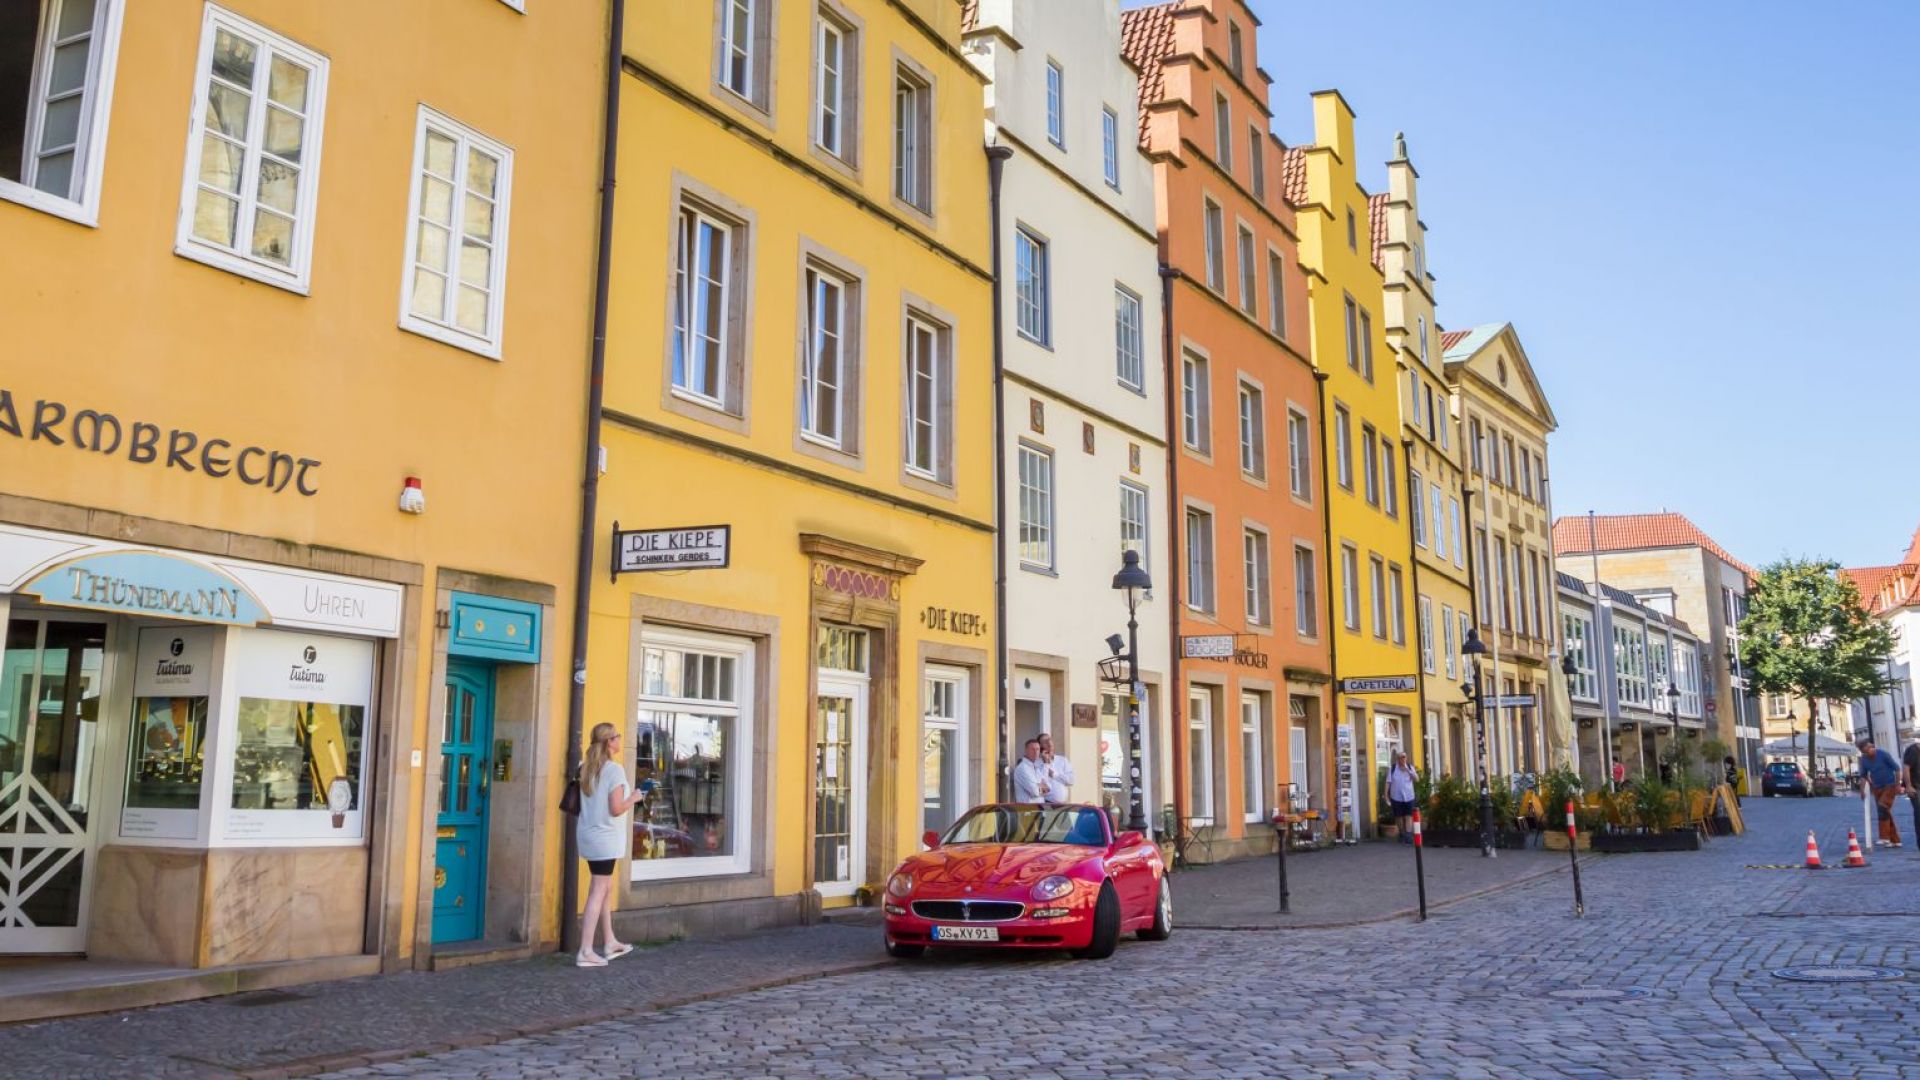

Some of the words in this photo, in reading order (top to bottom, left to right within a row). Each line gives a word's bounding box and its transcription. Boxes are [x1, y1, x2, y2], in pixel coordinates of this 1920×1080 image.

[632, 534, 659, 551] DIE
[669, 531, 714, 549] KIEPE
[635, 554, 675, 564] SCHINKEN
[67, 567, 240, 619] THÜNEMANN
[303, 585, 365, 619] UHREN
[436, 608, 451, 628] 11
[927, 606, 947, 631] DIE
[950, 611, 981, 636] KIEPE
[156, 659, 193, 676] Tutima
[289, 665, 326, 683] Tutima
[1350, 679, 1407, 690] CAFETERIA
